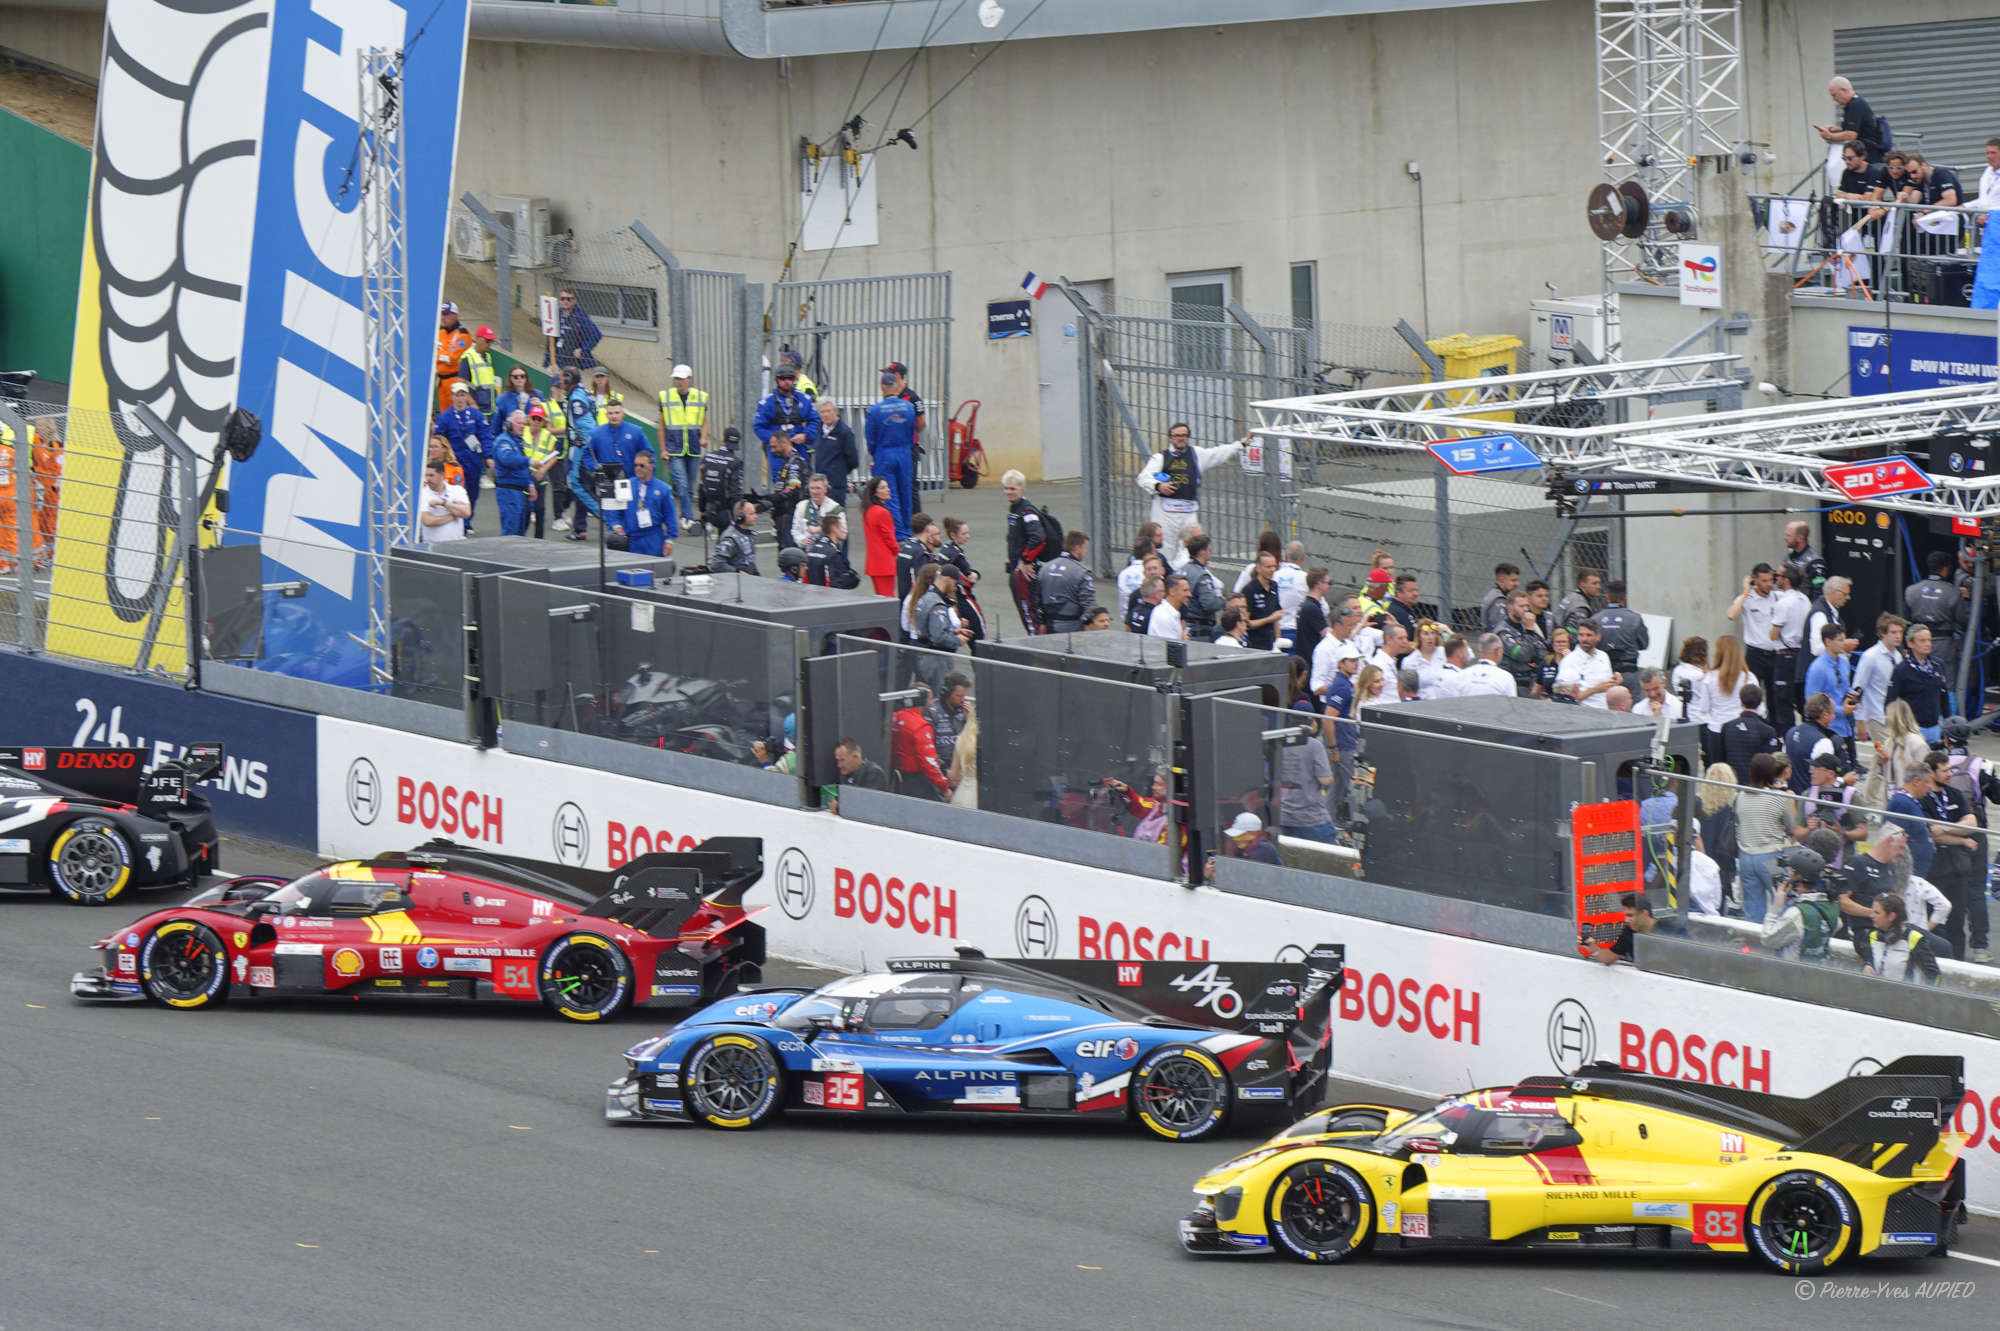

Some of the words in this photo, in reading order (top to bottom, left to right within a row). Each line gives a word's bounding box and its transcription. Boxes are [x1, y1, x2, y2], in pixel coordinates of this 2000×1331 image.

[1910, 359, 1938, 373] BMW
[1950, 362, 1980, 377] TEAM
[1451, 448, 1476, 462] 15
[1844, 472, 1874, 488] 20
[24, 752, 44, 766] HY
[57, 752, 136, 769] DENSO
[148, 778, 182, 788] JFE
[397, 775, 503, 845] BOSCH
[607, 821, 708, 870] BOS
[532, 899, 554, 916] HY
[834, 867, 957, 939] BOSCH
[453, 947, 501, 957] RICHARD
[503, 949, 536, 958] MILLE
[503, 965, 531, 988] 51
[1118, 966, 1141, 982] HY
[1266, 986, 1287, 995] elf
[735, 1004, 761, 1016] elf
[1339, 967, 1480, 1046] BOSCH
[1075, 1039, 1117, 1059] elf
[1620, 1021, 1771, 1094] BOSCH
[914, 1071, 1017, 1081] ALPINE
[827, 1076, 860, 1105] 35
[1520, 1102, 1557, 1110] ORLEN
[1720, 1132, 1744, 1152] HY
[1546, 1191, 1598, 1200] RICHARD
[1603, 1190, 1638, 1199] MILLE
[1401, 1222, 1426, 1236] CAR
[1704, 1210, 1737, 1237] 83
